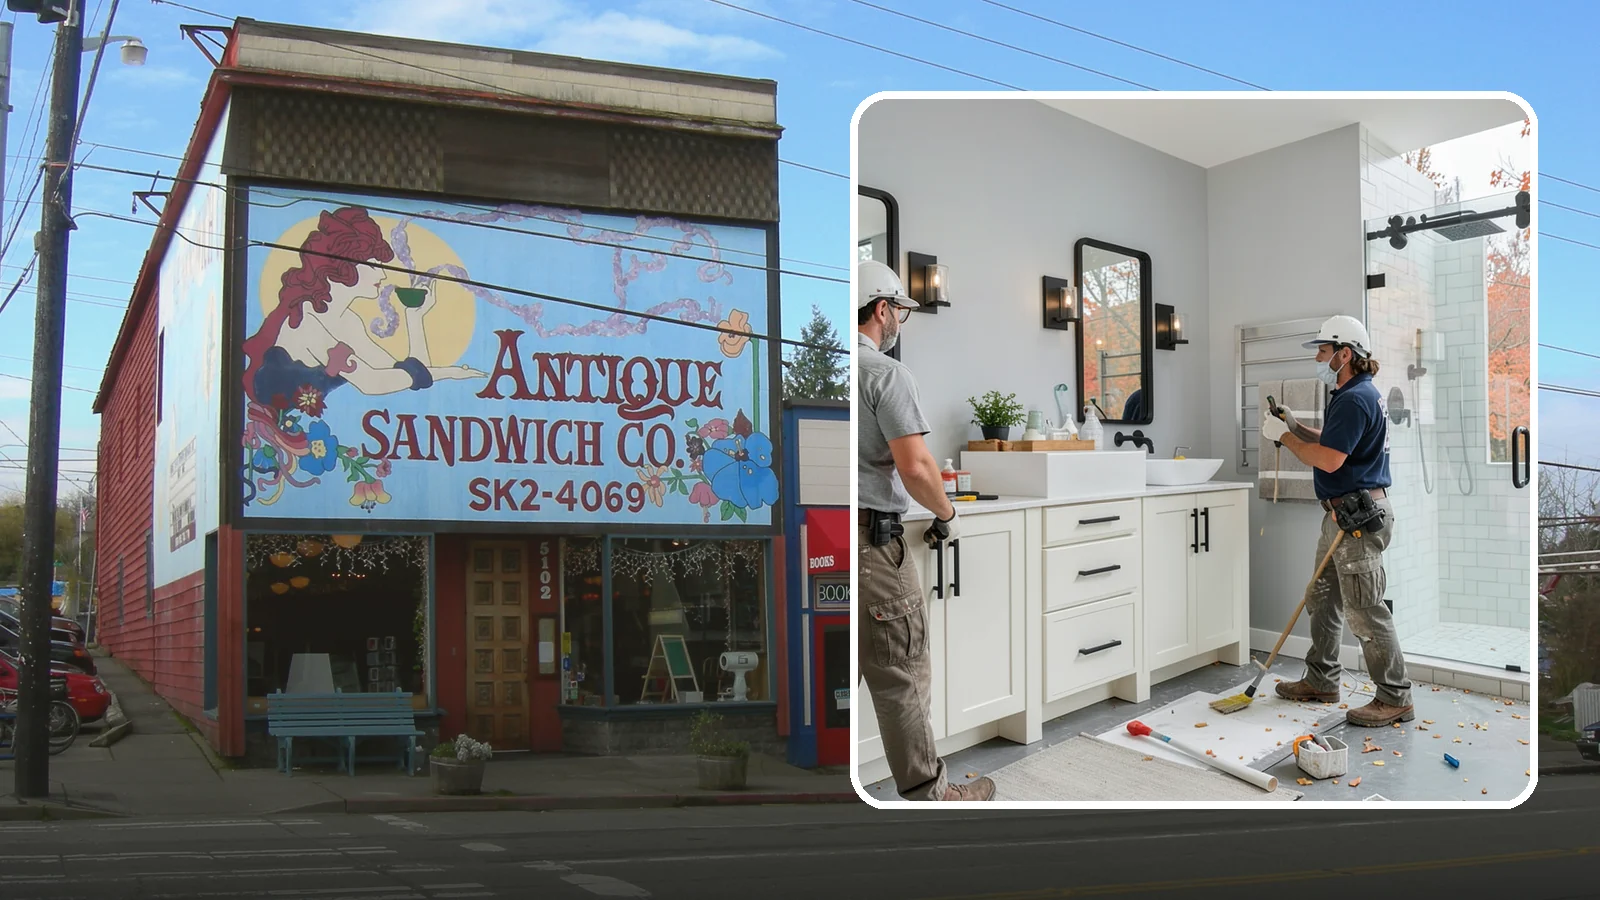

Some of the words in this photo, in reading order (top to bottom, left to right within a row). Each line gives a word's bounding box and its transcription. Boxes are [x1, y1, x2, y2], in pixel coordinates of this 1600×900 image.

[361, 408, 605, 467] SANDWICH
[617, 421, 686, 468] CO.
[468, 477, 646, 513] SK2-4069
[539, 541, 552, 600] 5102
[809, 555, 835, 569] BOOKS
